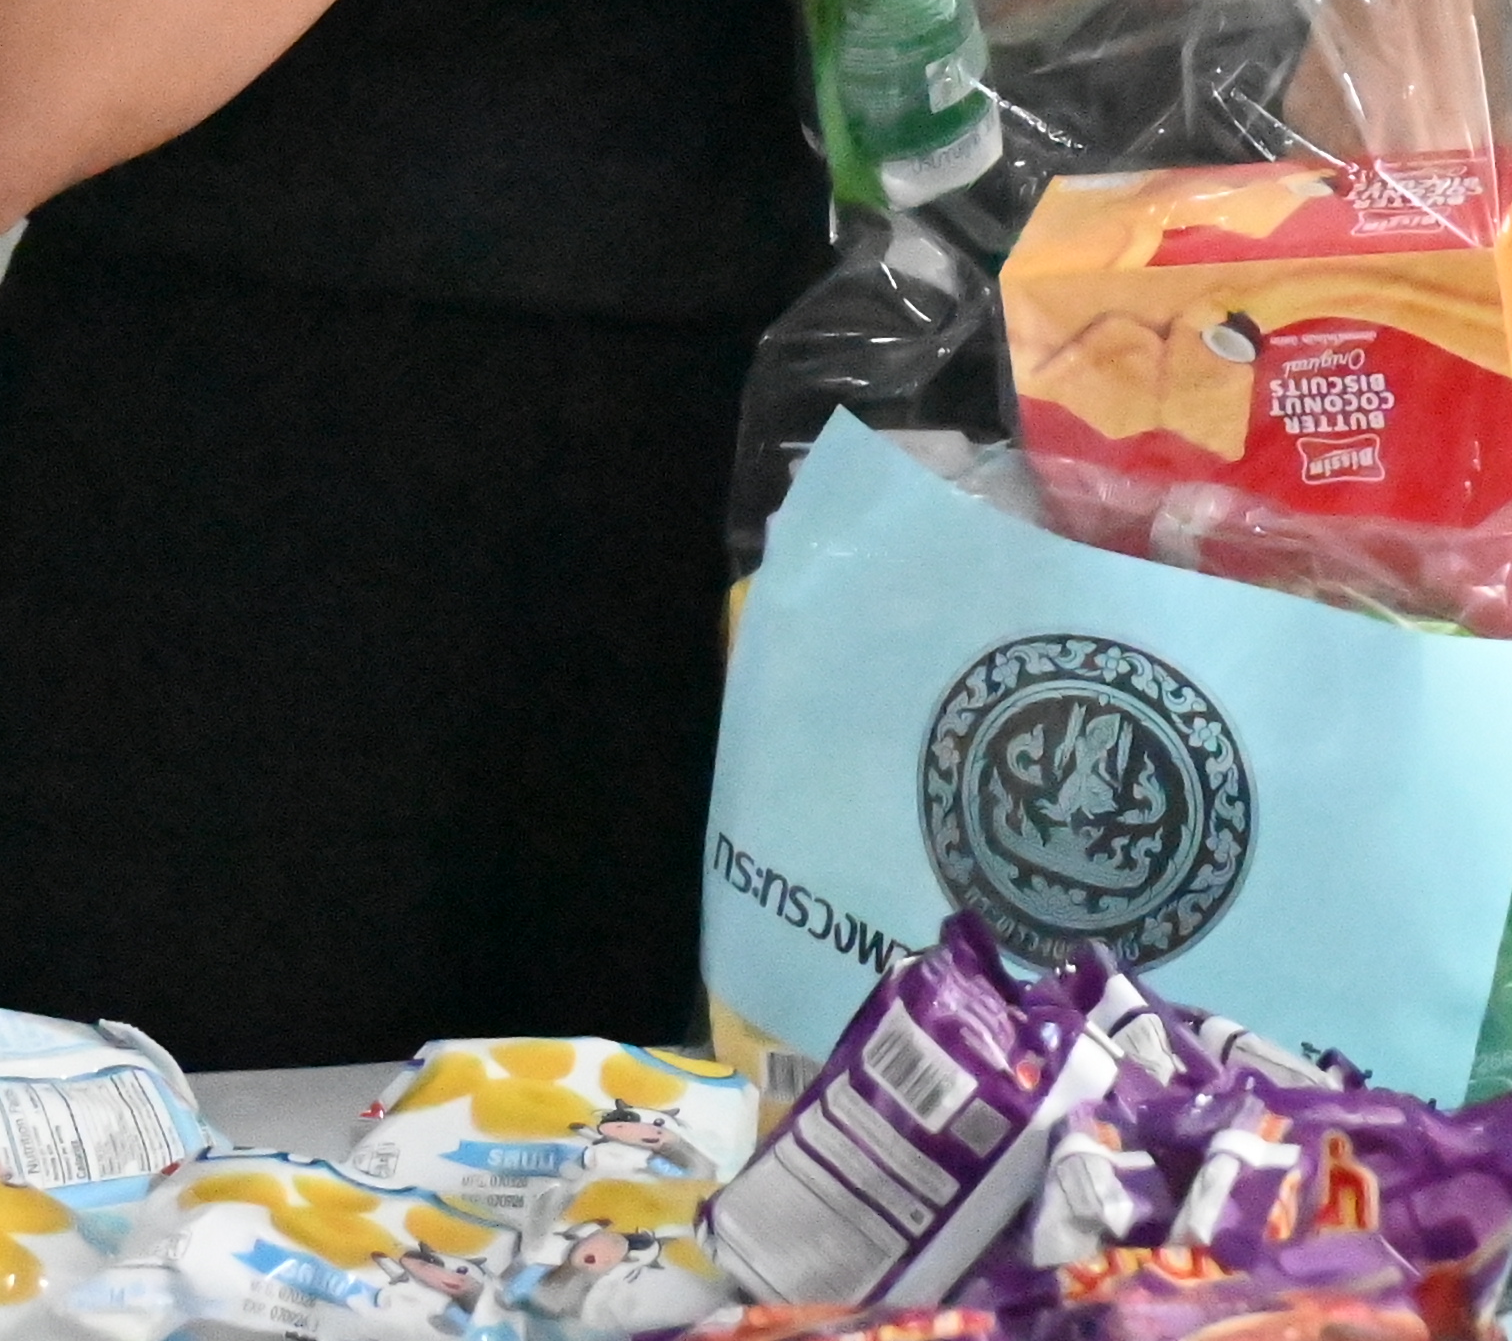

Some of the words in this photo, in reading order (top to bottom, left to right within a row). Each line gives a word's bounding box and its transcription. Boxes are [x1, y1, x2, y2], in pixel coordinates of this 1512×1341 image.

[1283, 348, 1366, 378] Original
[1269, 373, 1387, 397] BISCUITS
[1269, 391, 1395, 416] COCONUT
[1283, 410, 1386, 434] BUTTER
[1308, 446, 1374, 477] Bissin
[16, 1118, 40, 1175] Nutrition
